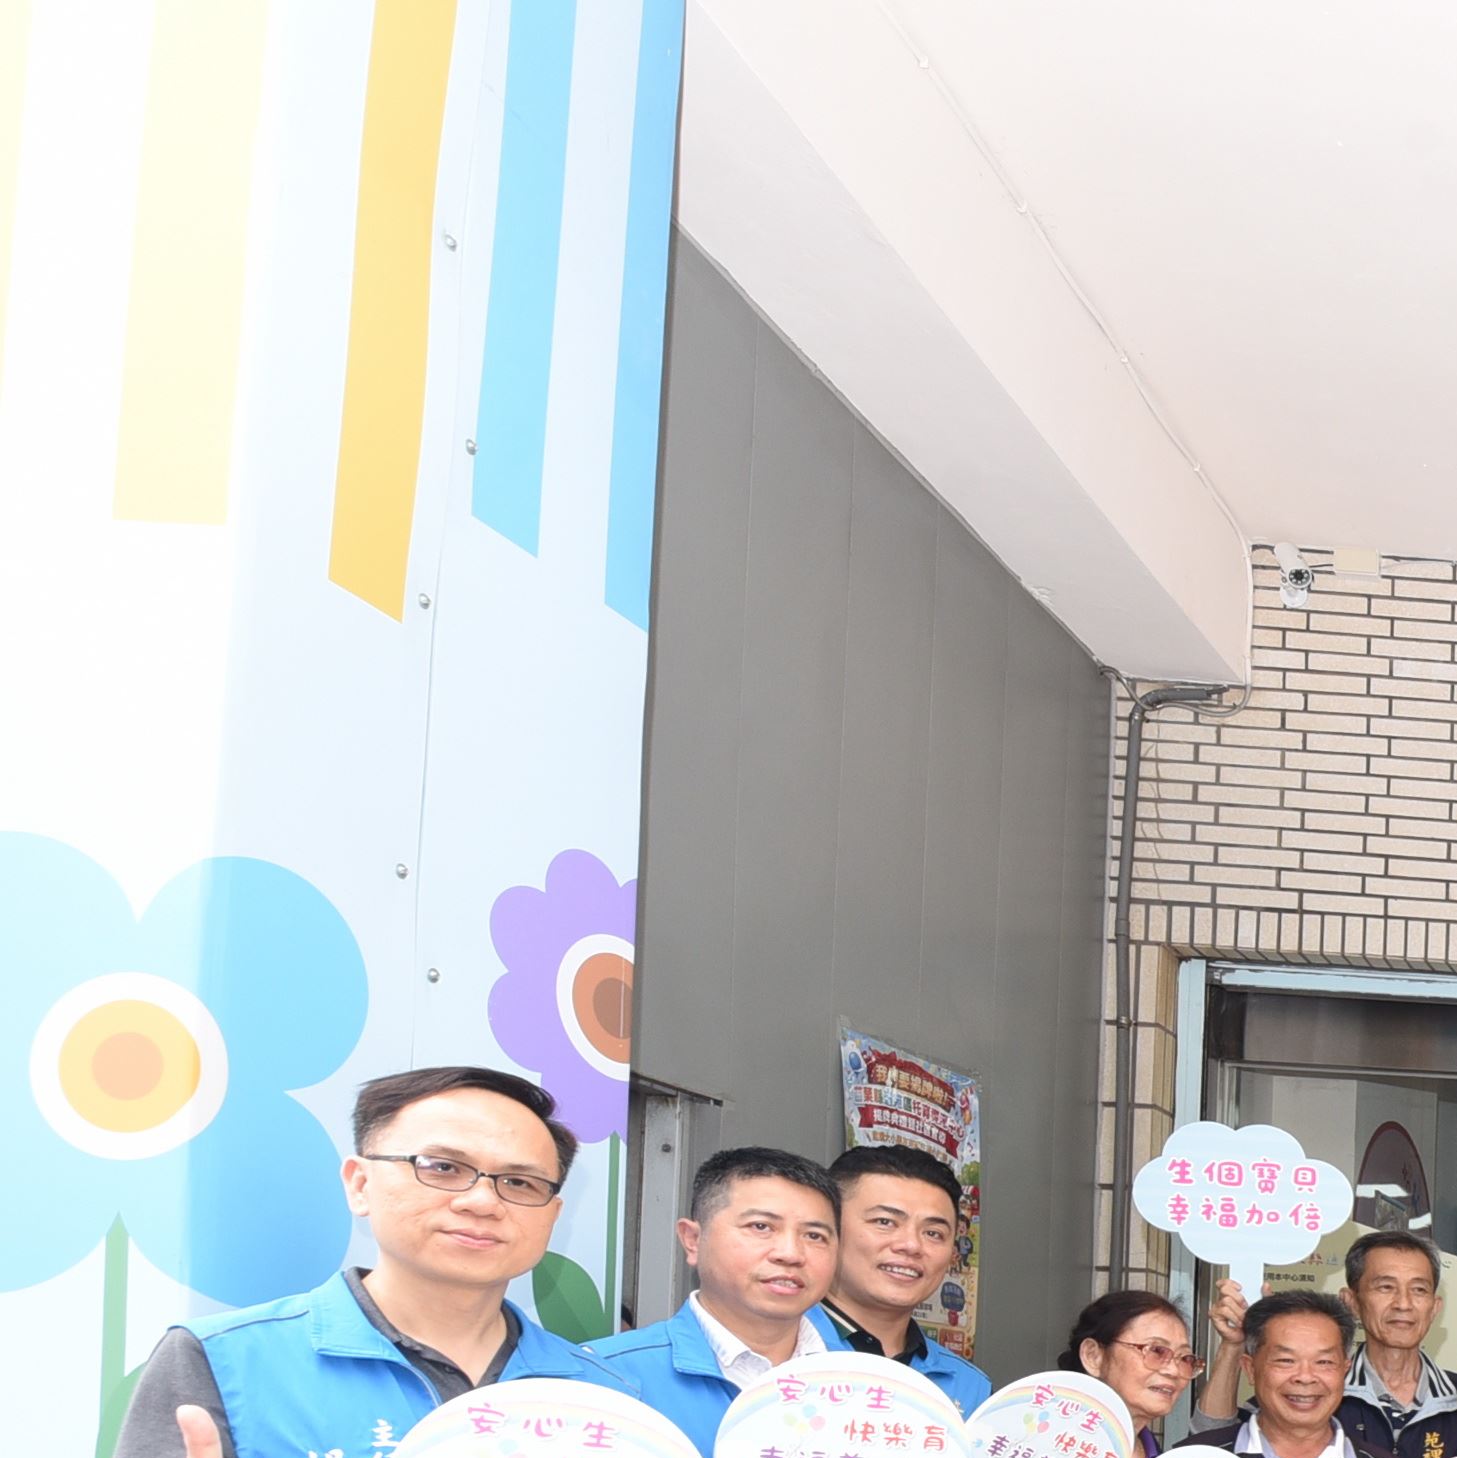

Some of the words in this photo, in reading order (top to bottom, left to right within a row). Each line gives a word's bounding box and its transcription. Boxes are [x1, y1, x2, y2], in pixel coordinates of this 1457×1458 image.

[1167, 1157, 1319, 1195] 生個寶貝
[1167, 1195, 1322, 1232] 幸福加倍
[776, 1374, 896, 1411] 安心生
[1029, 1384, 1105, 1433] 安心生
[468, 1402, 617, 1450] 安心生
[843, 1421, 949, 1453] 快樂育
